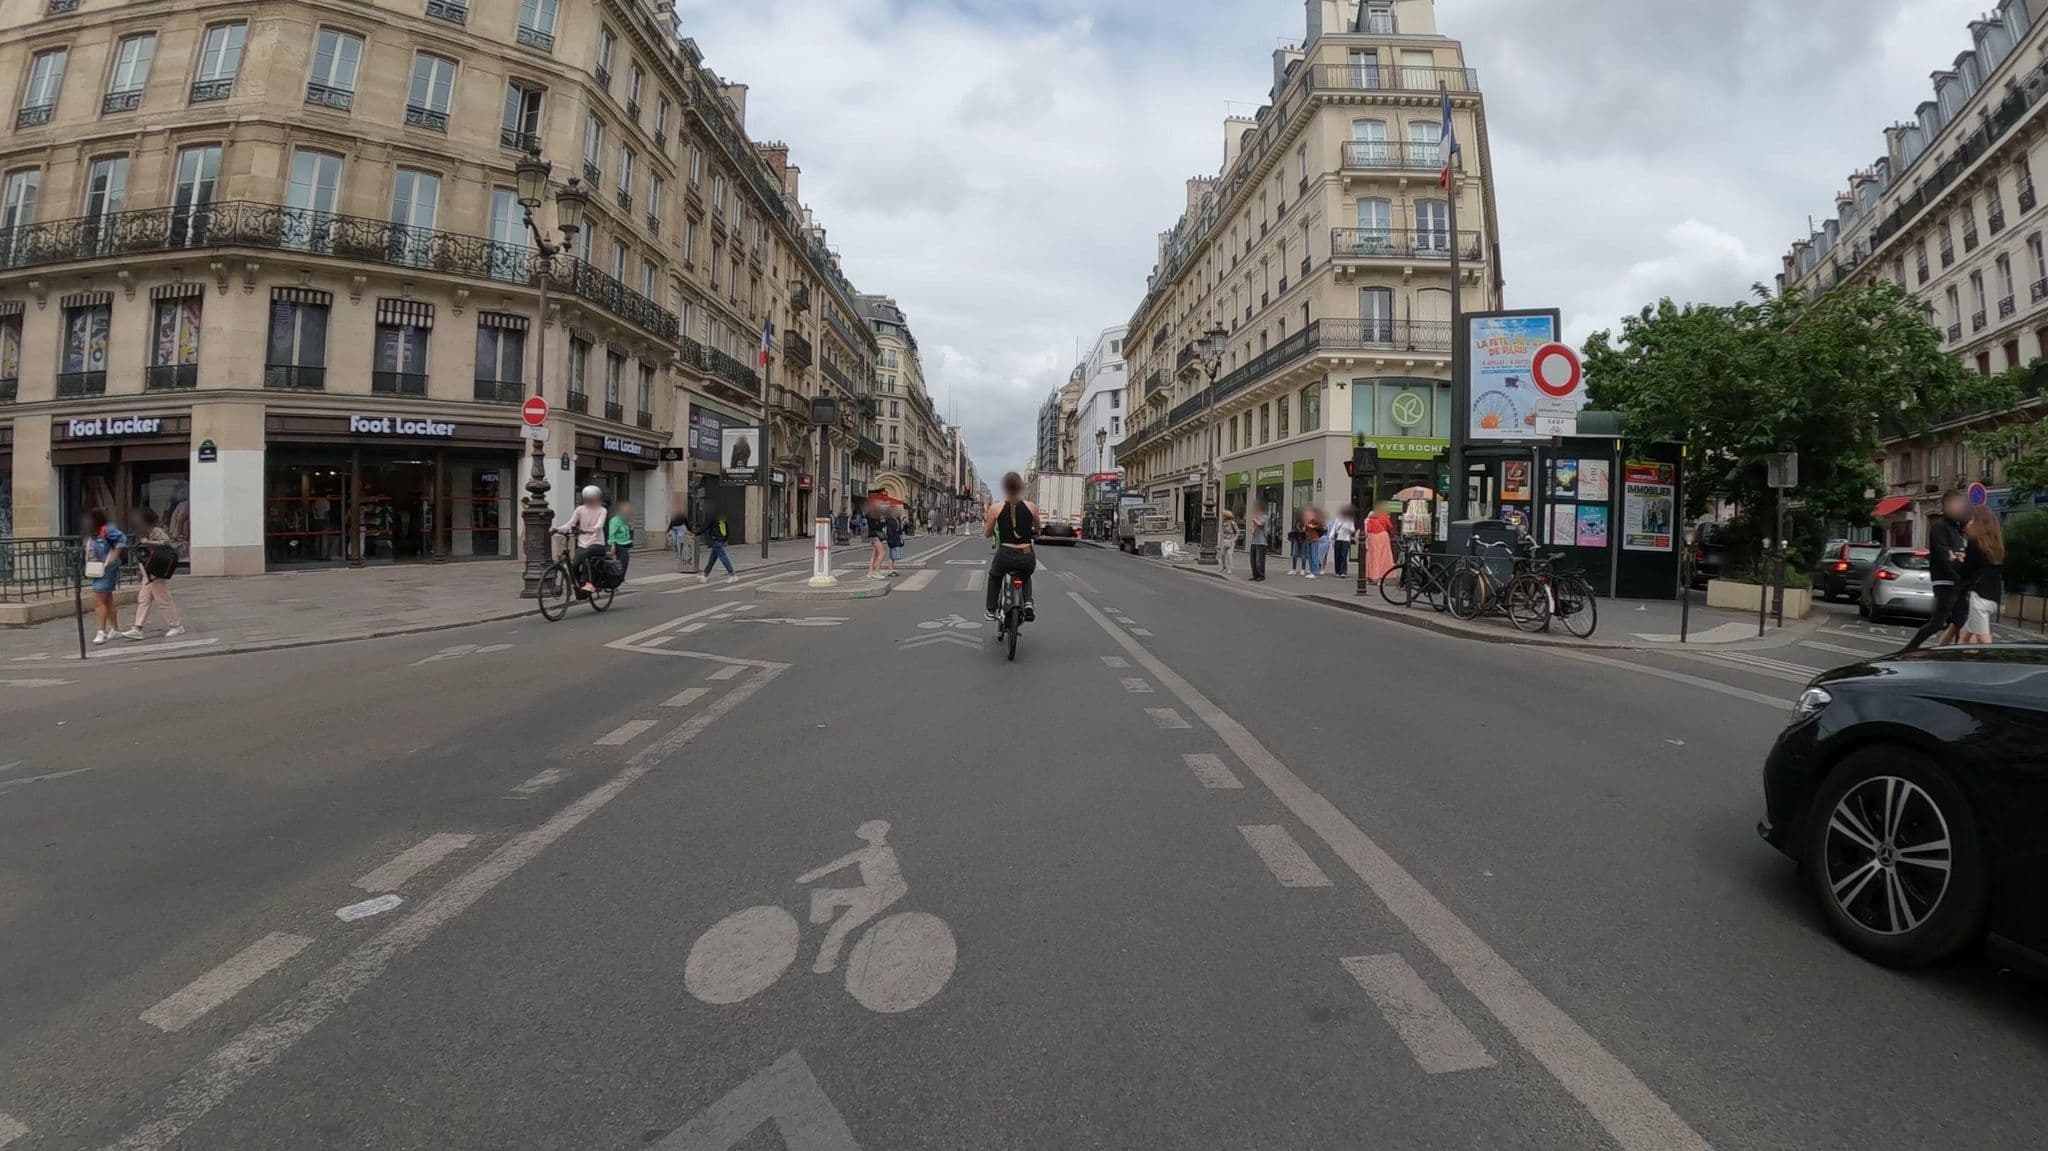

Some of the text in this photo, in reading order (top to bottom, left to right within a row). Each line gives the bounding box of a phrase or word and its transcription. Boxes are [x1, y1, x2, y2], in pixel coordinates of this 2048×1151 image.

[106, 415, 160, 435] Locker
[396, 416, 456, 436] Locker
[1379, 443, 1450, 452] YVES ROCH
[481, 473, 499, 481] MEN
[1627, 484, 1672, 497] IMMOBILIER
